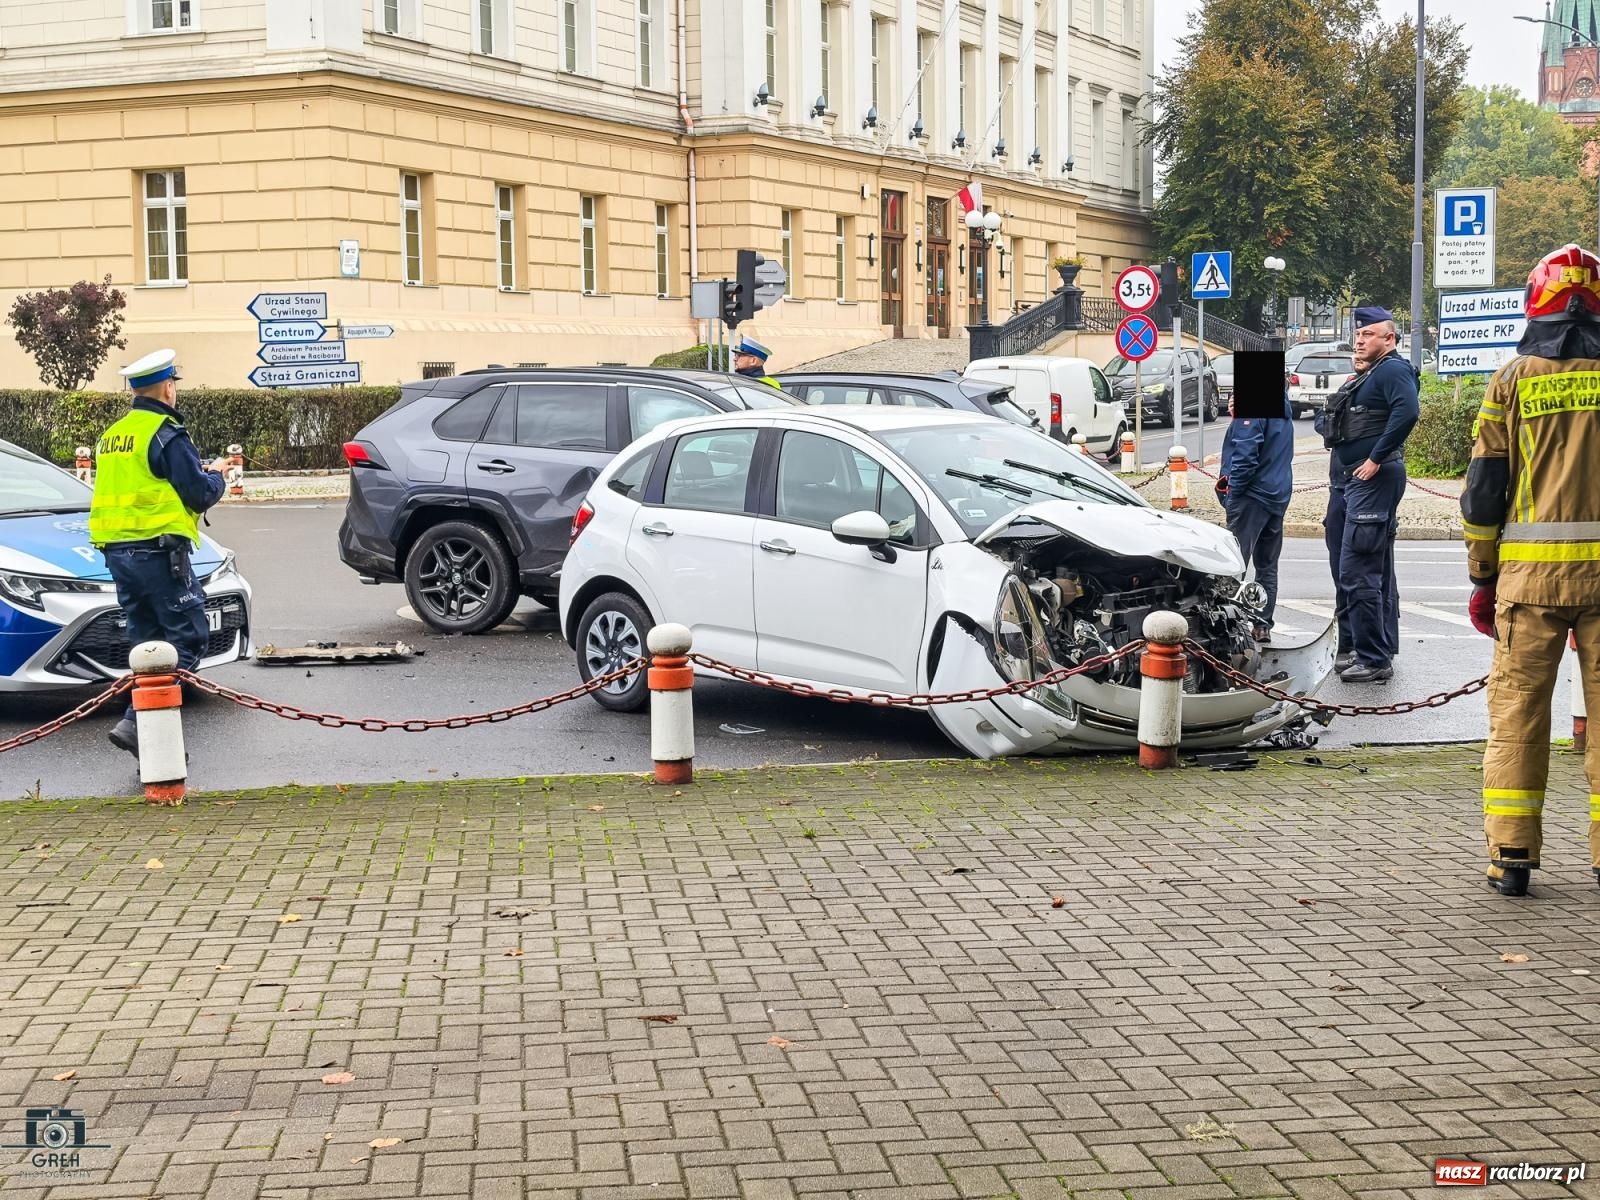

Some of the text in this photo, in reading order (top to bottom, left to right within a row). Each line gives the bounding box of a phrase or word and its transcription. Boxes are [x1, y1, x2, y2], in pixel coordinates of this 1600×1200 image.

[1453, 200, 1477, 231] P
[1122, 279, 1152, 299] 3,5t
[294, 296, 321, 304] Stanu
[1480, 297, 1519, 311] Miasta
[270, 307, 318, 318] Cywilnego
[264, 327, 315, 338] Centrum
[1443, 324, 1515, 340] Dworzec PKP
[308, 352, 341, 360] Raciborzu
[1442, 354, 1478, 367] Poczta
[260, 368, 356, 382] Straż Graniczna
